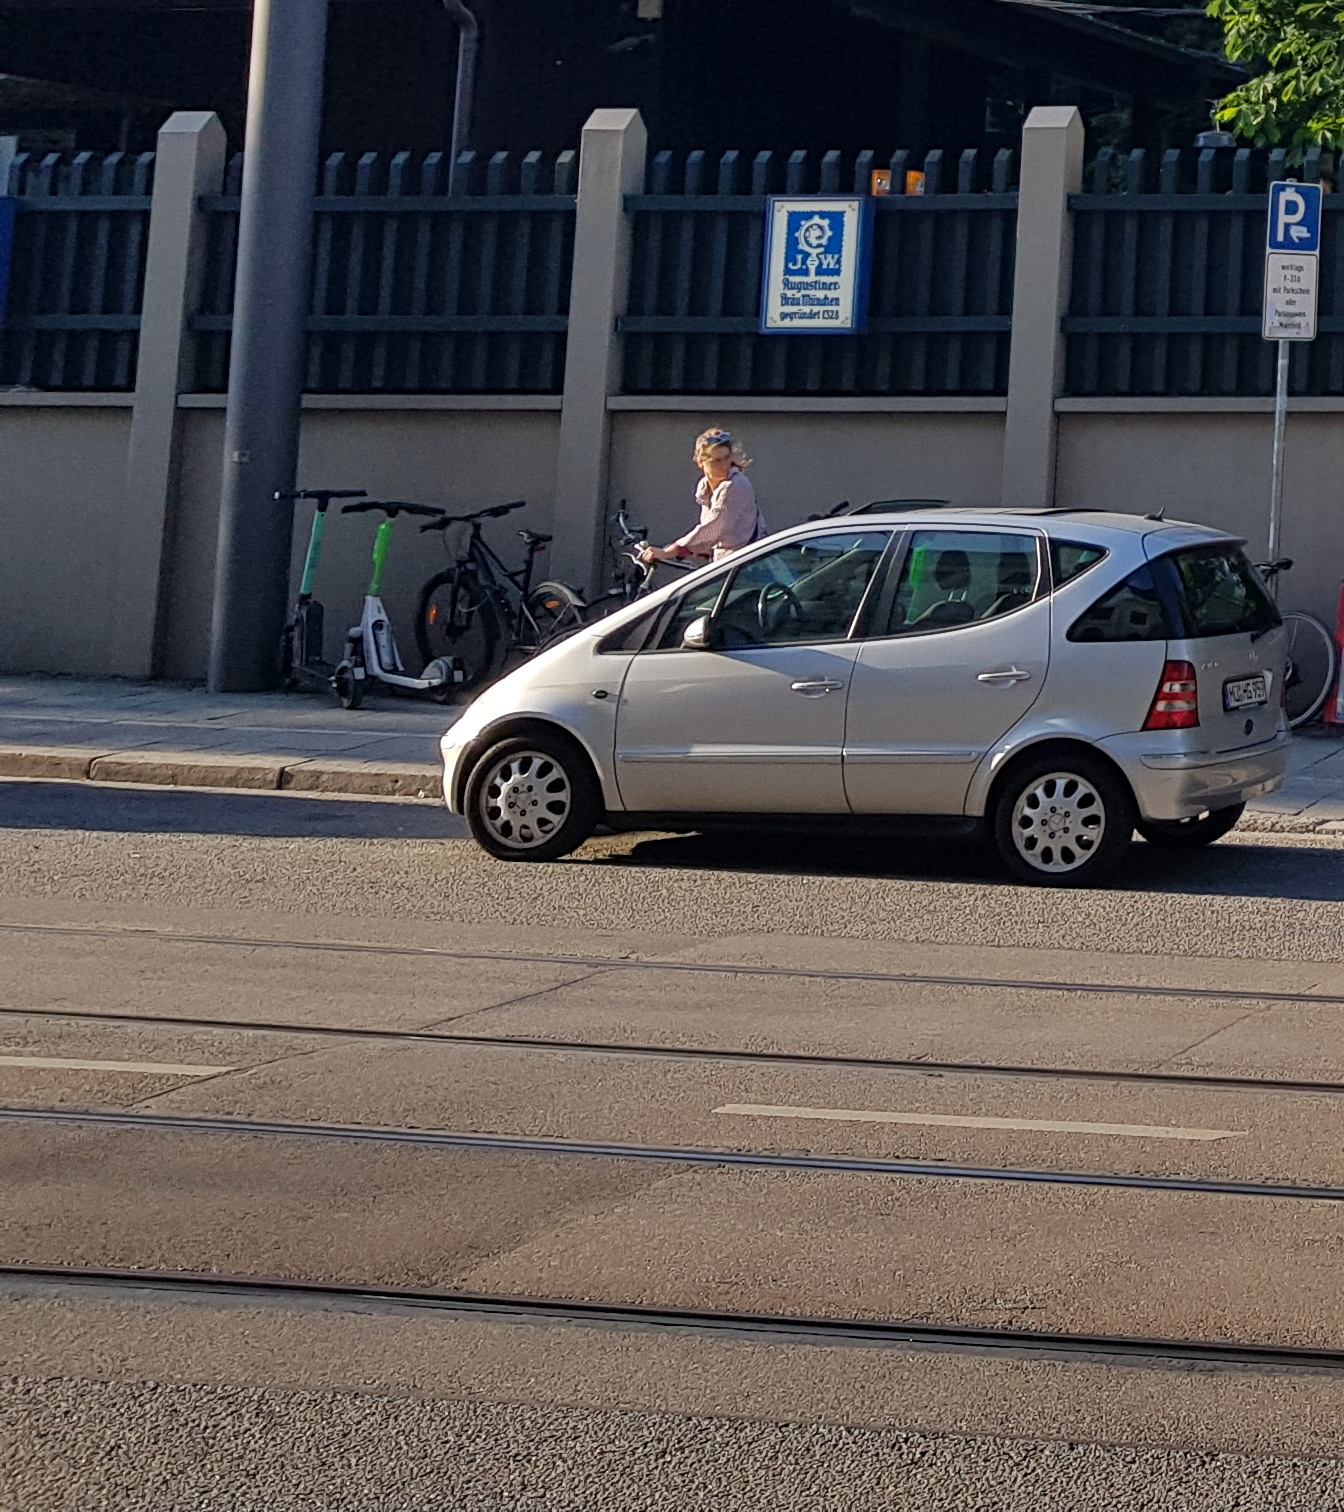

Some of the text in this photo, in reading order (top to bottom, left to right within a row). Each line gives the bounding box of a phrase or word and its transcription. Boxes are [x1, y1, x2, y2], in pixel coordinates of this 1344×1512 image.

[1276, 191, 1306, 242] P
[788, 253, 840, 270] J. W.
